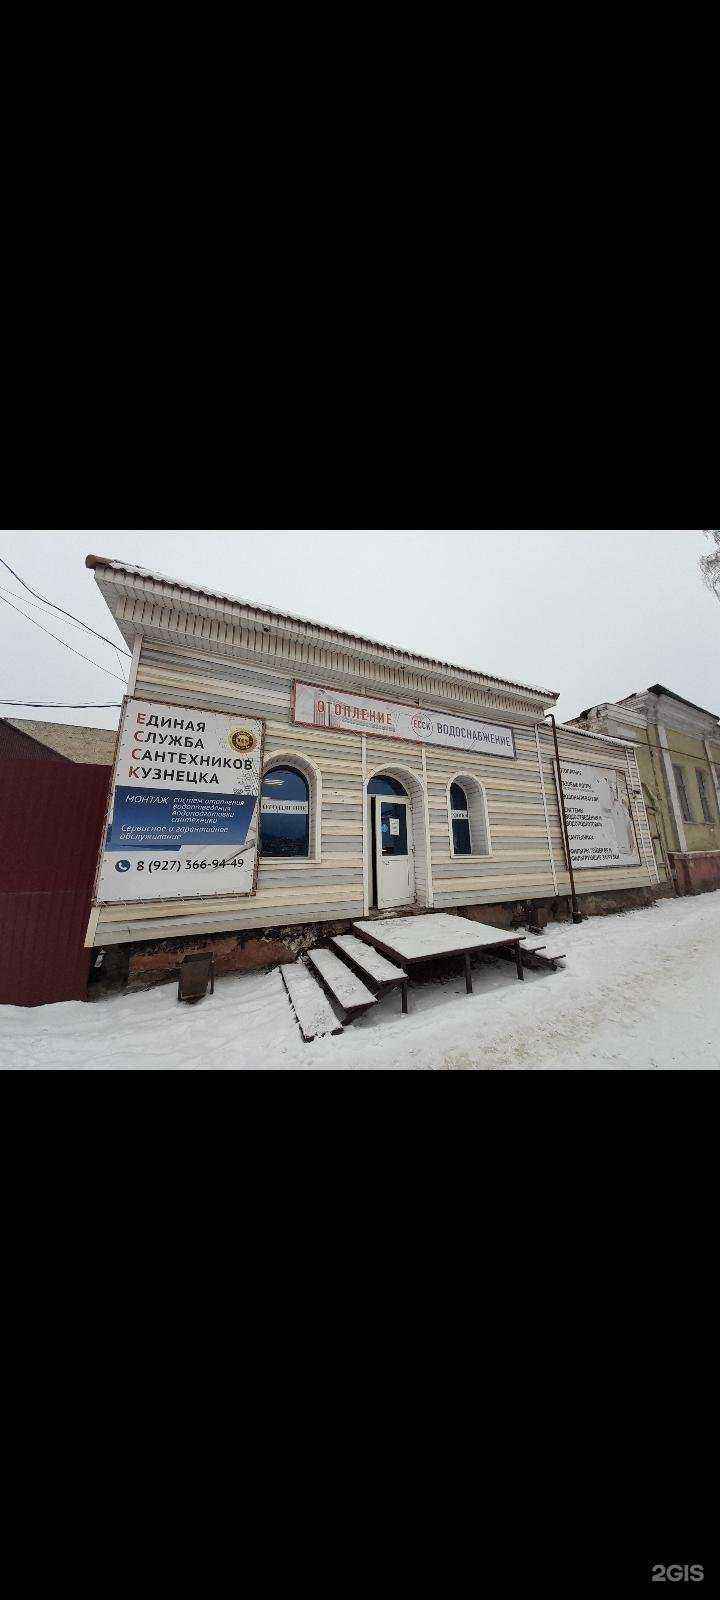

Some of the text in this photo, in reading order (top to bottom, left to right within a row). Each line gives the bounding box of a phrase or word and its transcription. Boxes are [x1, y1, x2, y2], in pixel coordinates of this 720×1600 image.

[317, 700, 392, 725] ОТОПЛЕНИЕ
[136, 712, 206, 733] ЕДИНАЯ
[134, 730, 205, 750] СЛУЖБА
[437, 722, 511, 747] ВОДОСНАБЖЕНИЕ
[131, 748, 253, 771] САНТЕХНИКОВ
[128, 766, 220, 784] КУЗНЕЦКА
[125, 794, 170, 805] МОНТАЖ
[173, 797, 202, 805] систем
[119, 832, 182, 842] обслуживание
[121, 824, 167, 835] Сервисное
[175, 825, 229, 834] гарантийное
[136, 858, 244, 873] 8 (927) 366-94-49
